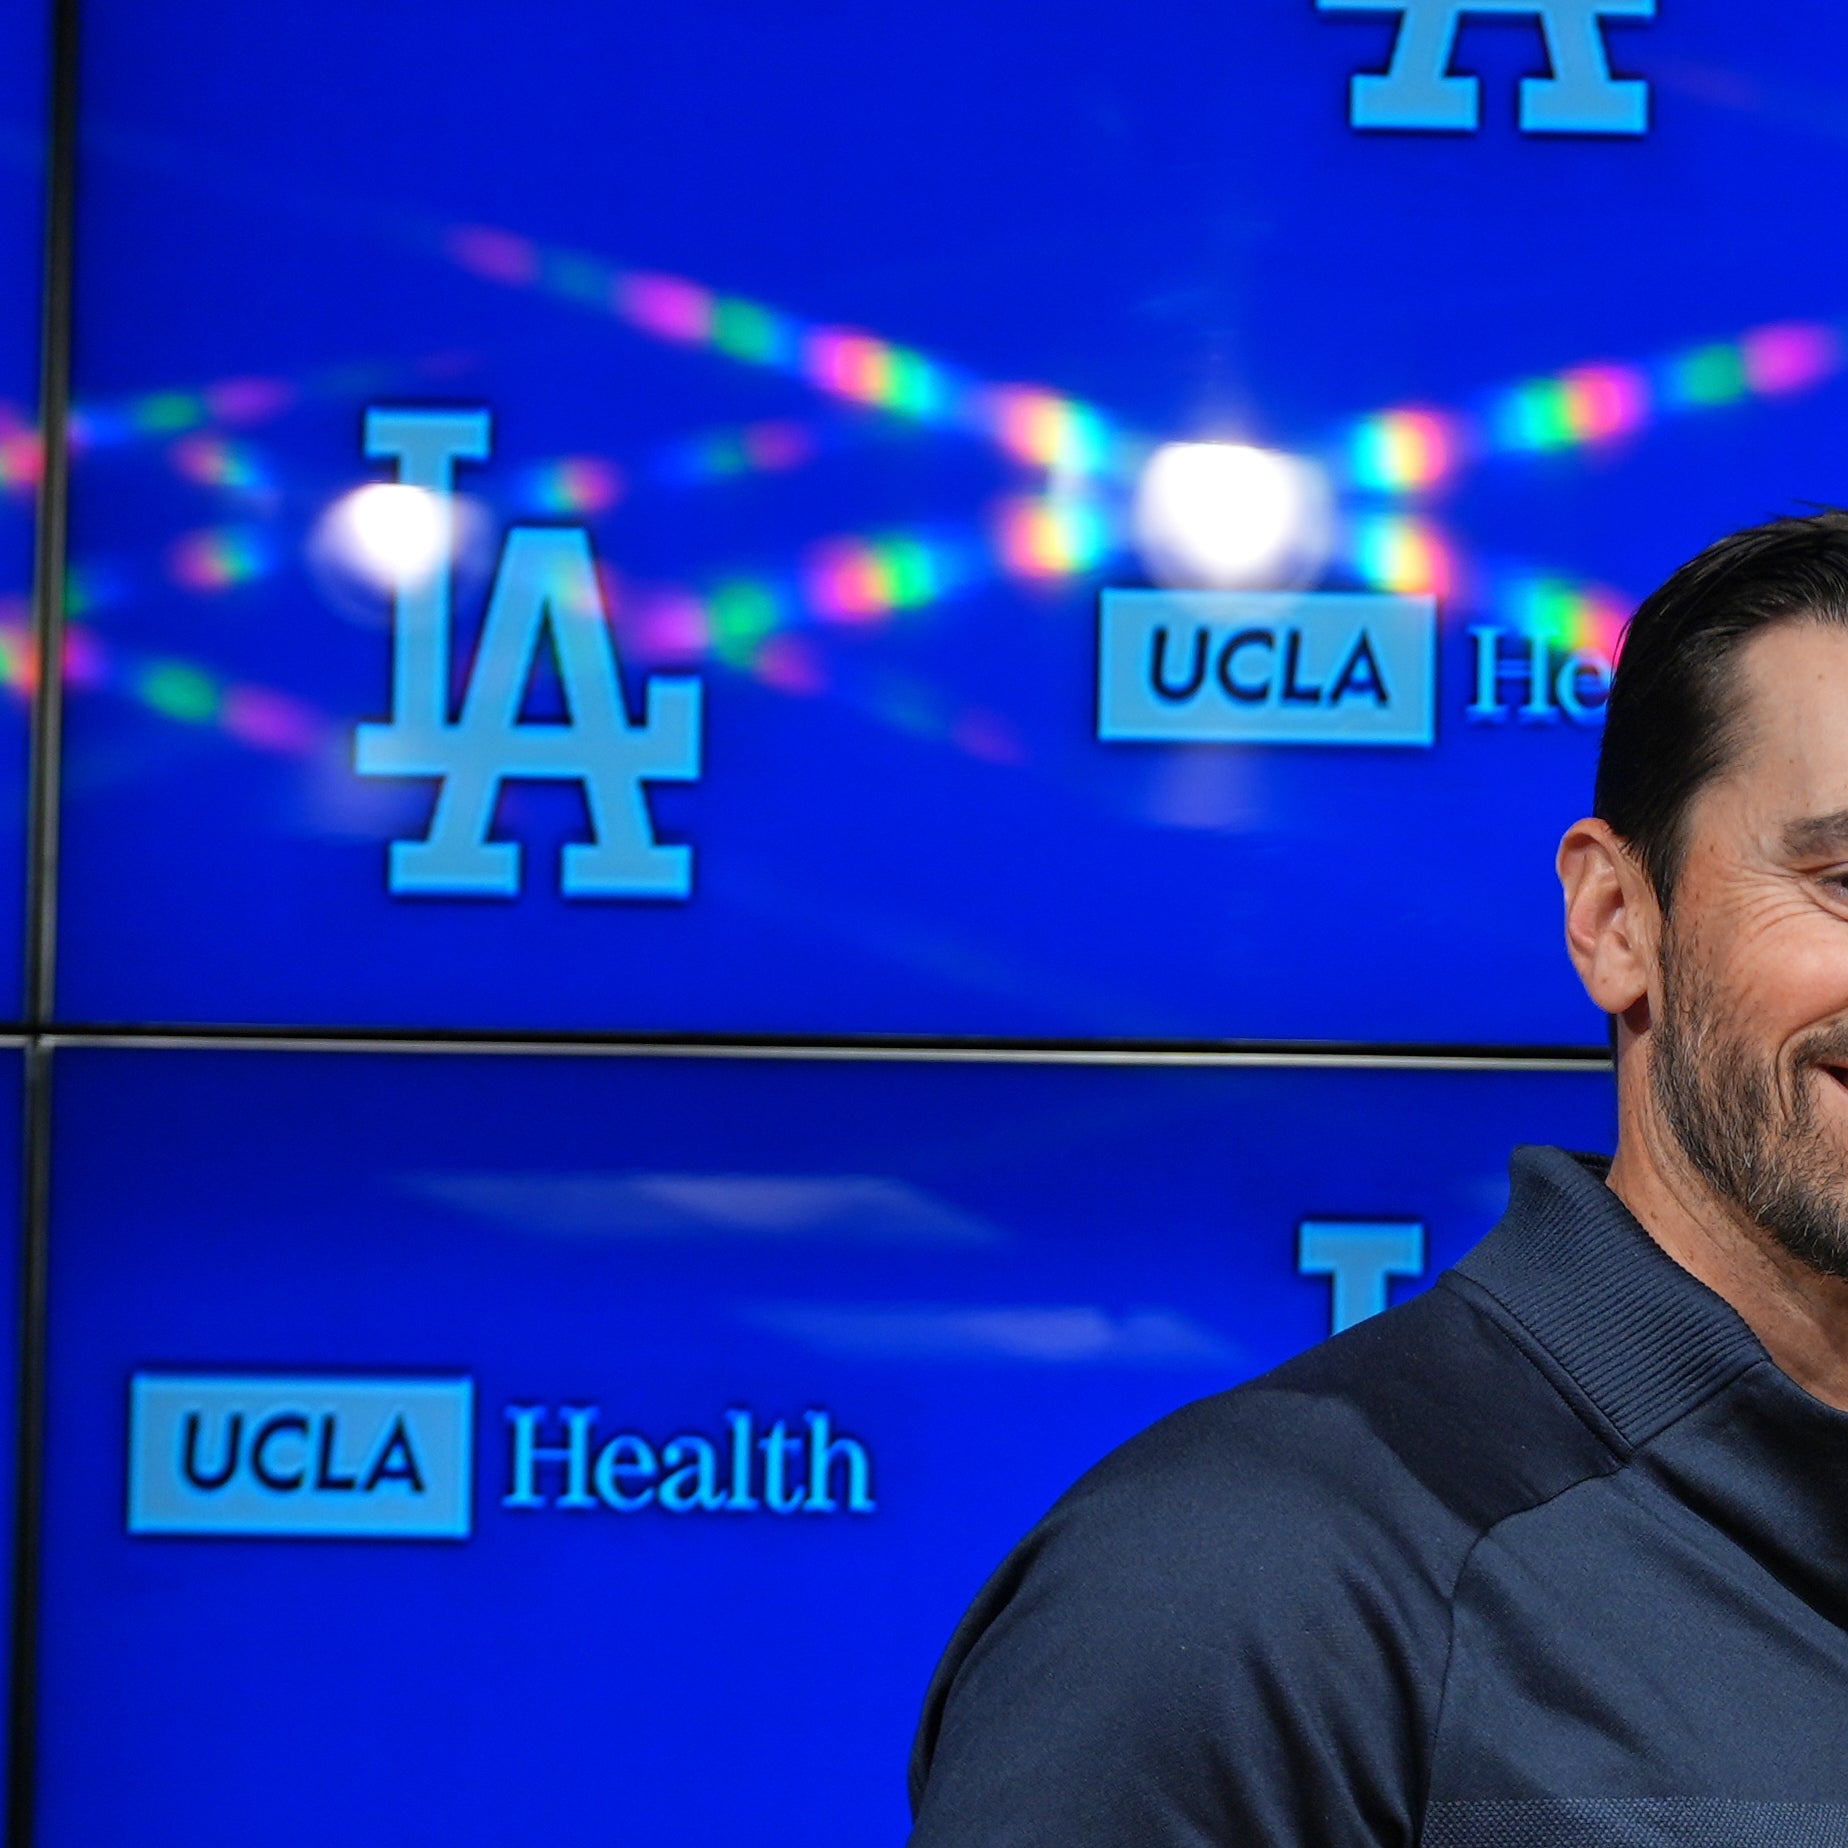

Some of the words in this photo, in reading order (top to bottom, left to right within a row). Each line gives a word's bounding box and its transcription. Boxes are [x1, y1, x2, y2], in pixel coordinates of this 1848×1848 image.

[355, 408, 700, 898] LA
[1148, 627, 1388, 707] UCLA
[181, 1409, 427, 1494] UCLA
[501, 1404, 876, 1514] Health
